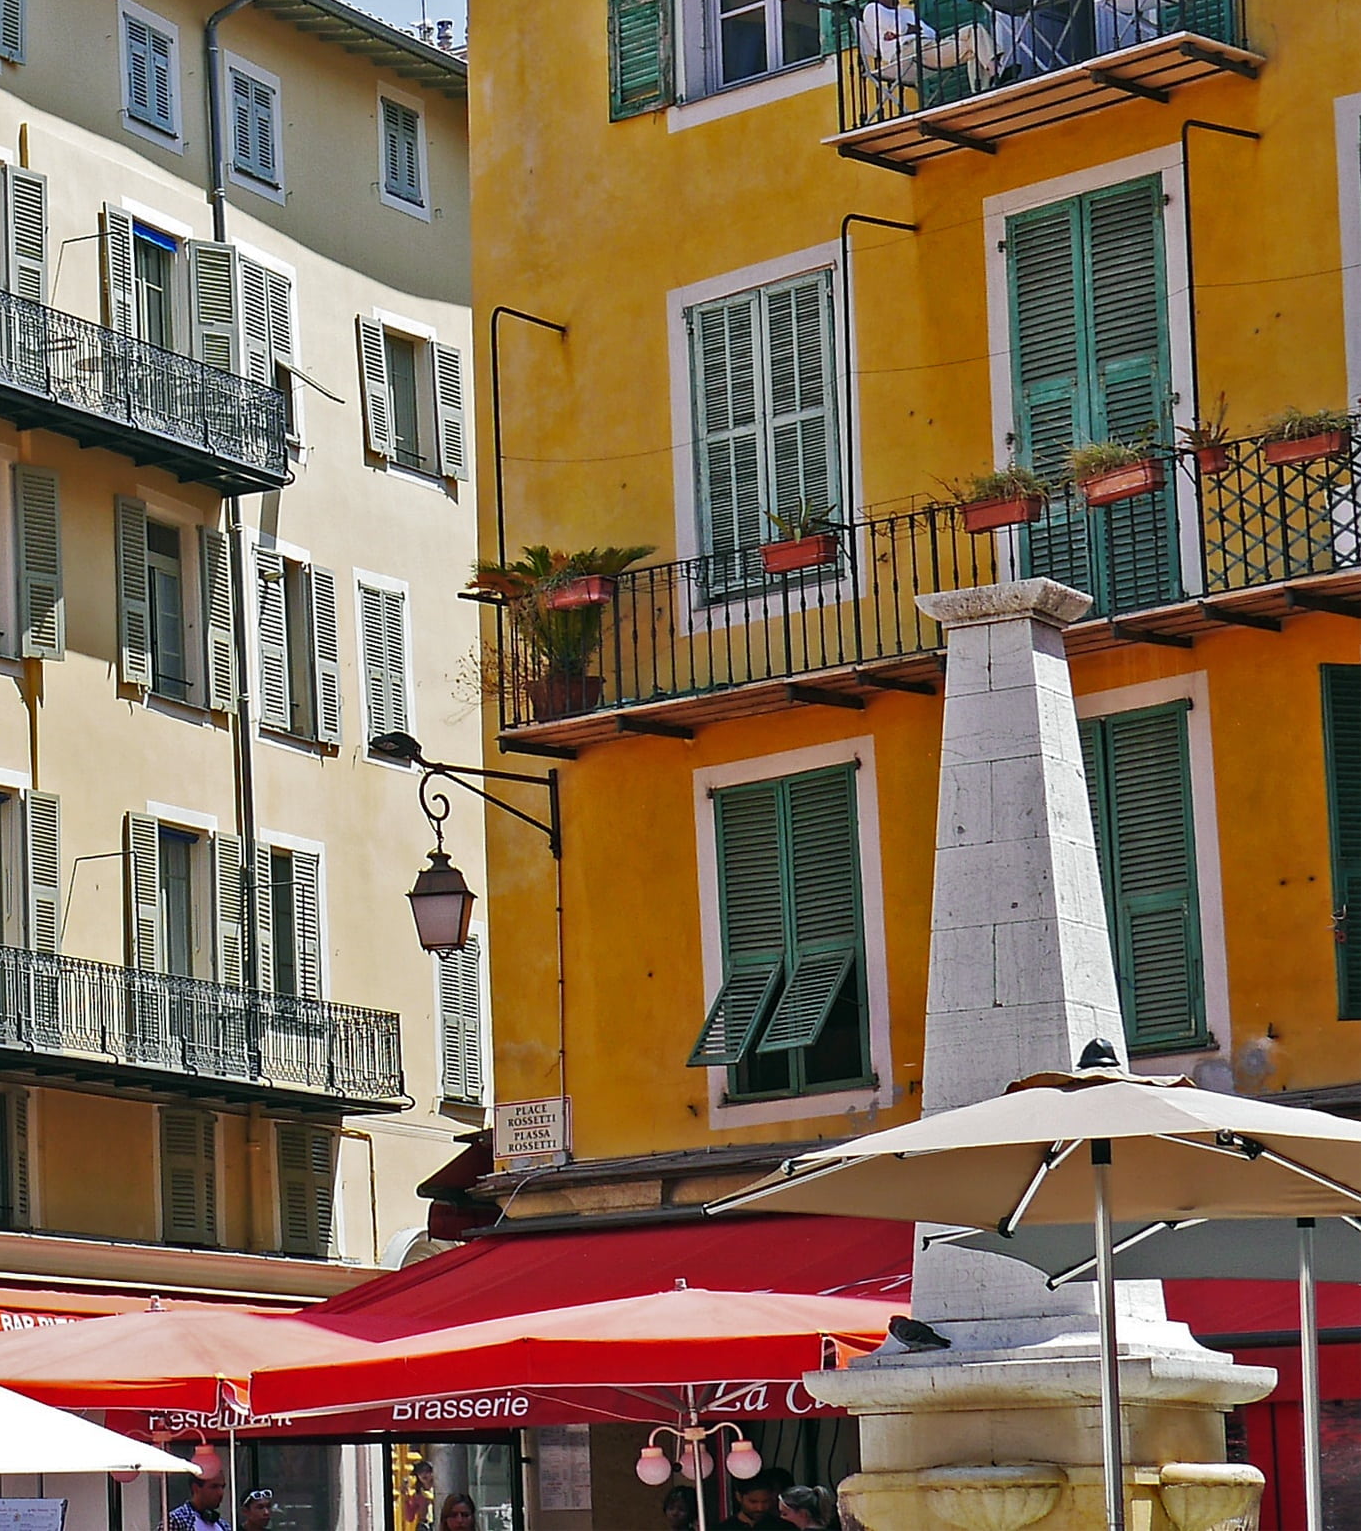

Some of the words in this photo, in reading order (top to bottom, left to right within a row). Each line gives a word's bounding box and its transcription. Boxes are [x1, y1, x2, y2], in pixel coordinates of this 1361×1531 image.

[515, 1104, 548, 1115] PLACE
[507, 1114, 556, 1127] ROSSETTI
[514, 1129, 551, 1141] PLASSA
[508, 1140, 556, 1152] ROSSETTI
[392, 1392, 529, 1421] Brasserie
